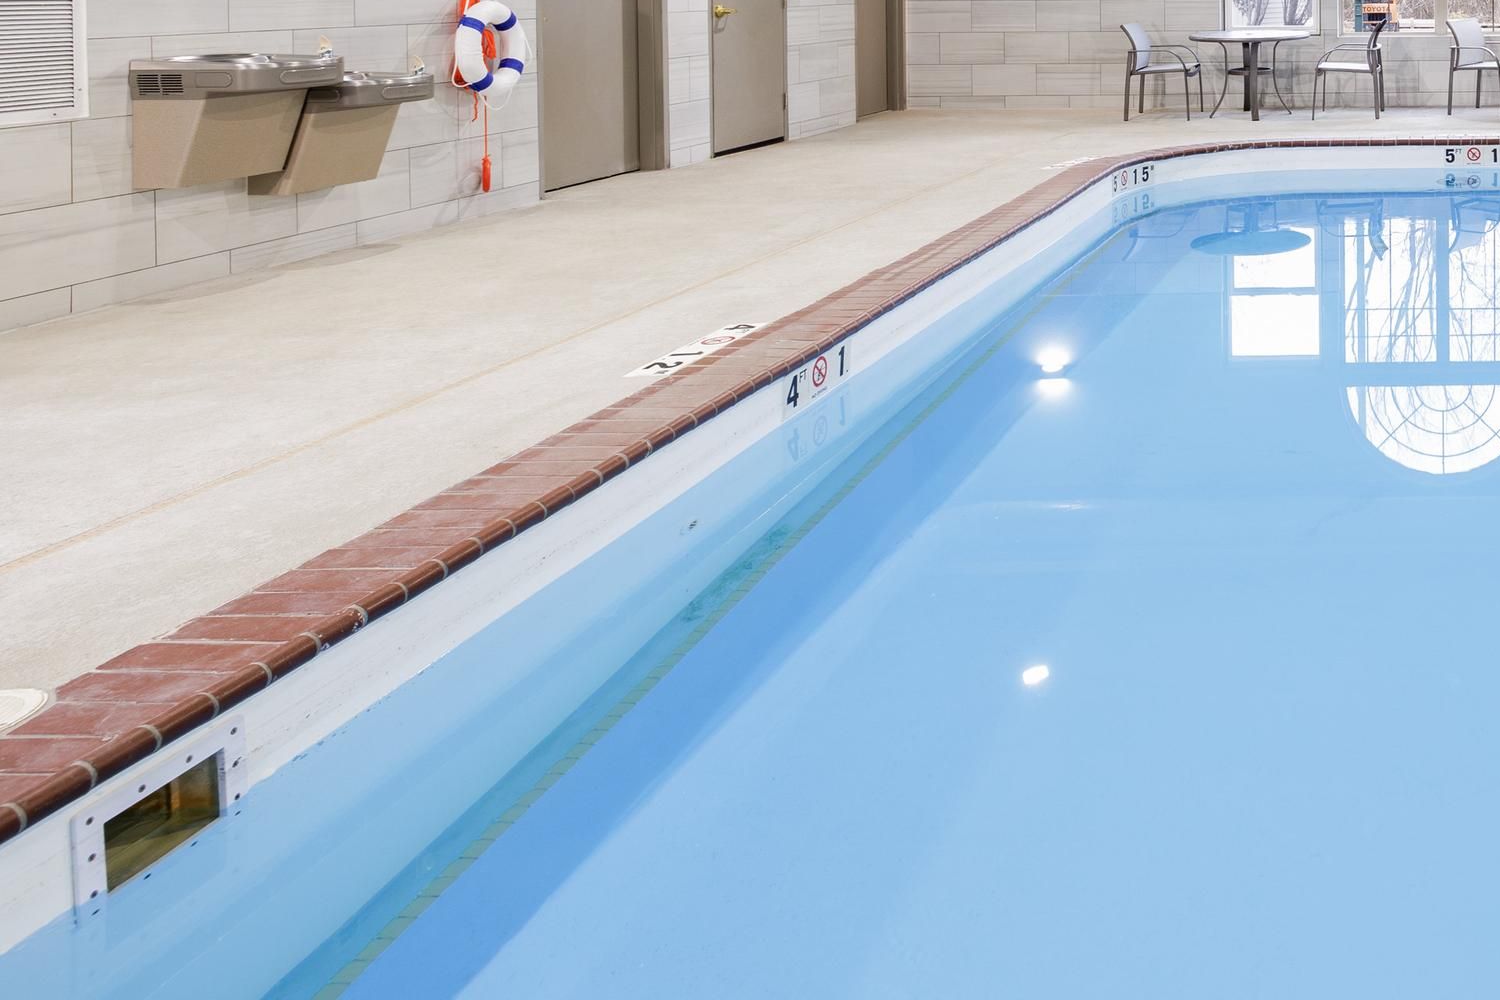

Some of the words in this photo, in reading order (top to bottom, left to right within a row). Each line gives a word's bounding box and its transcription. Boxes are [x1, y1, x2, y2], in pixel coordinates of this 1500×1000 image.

[1445, 148, 1455, 163] 5
[787, 374, 799, 408] 4
[799, 368, 808, 384] FT
